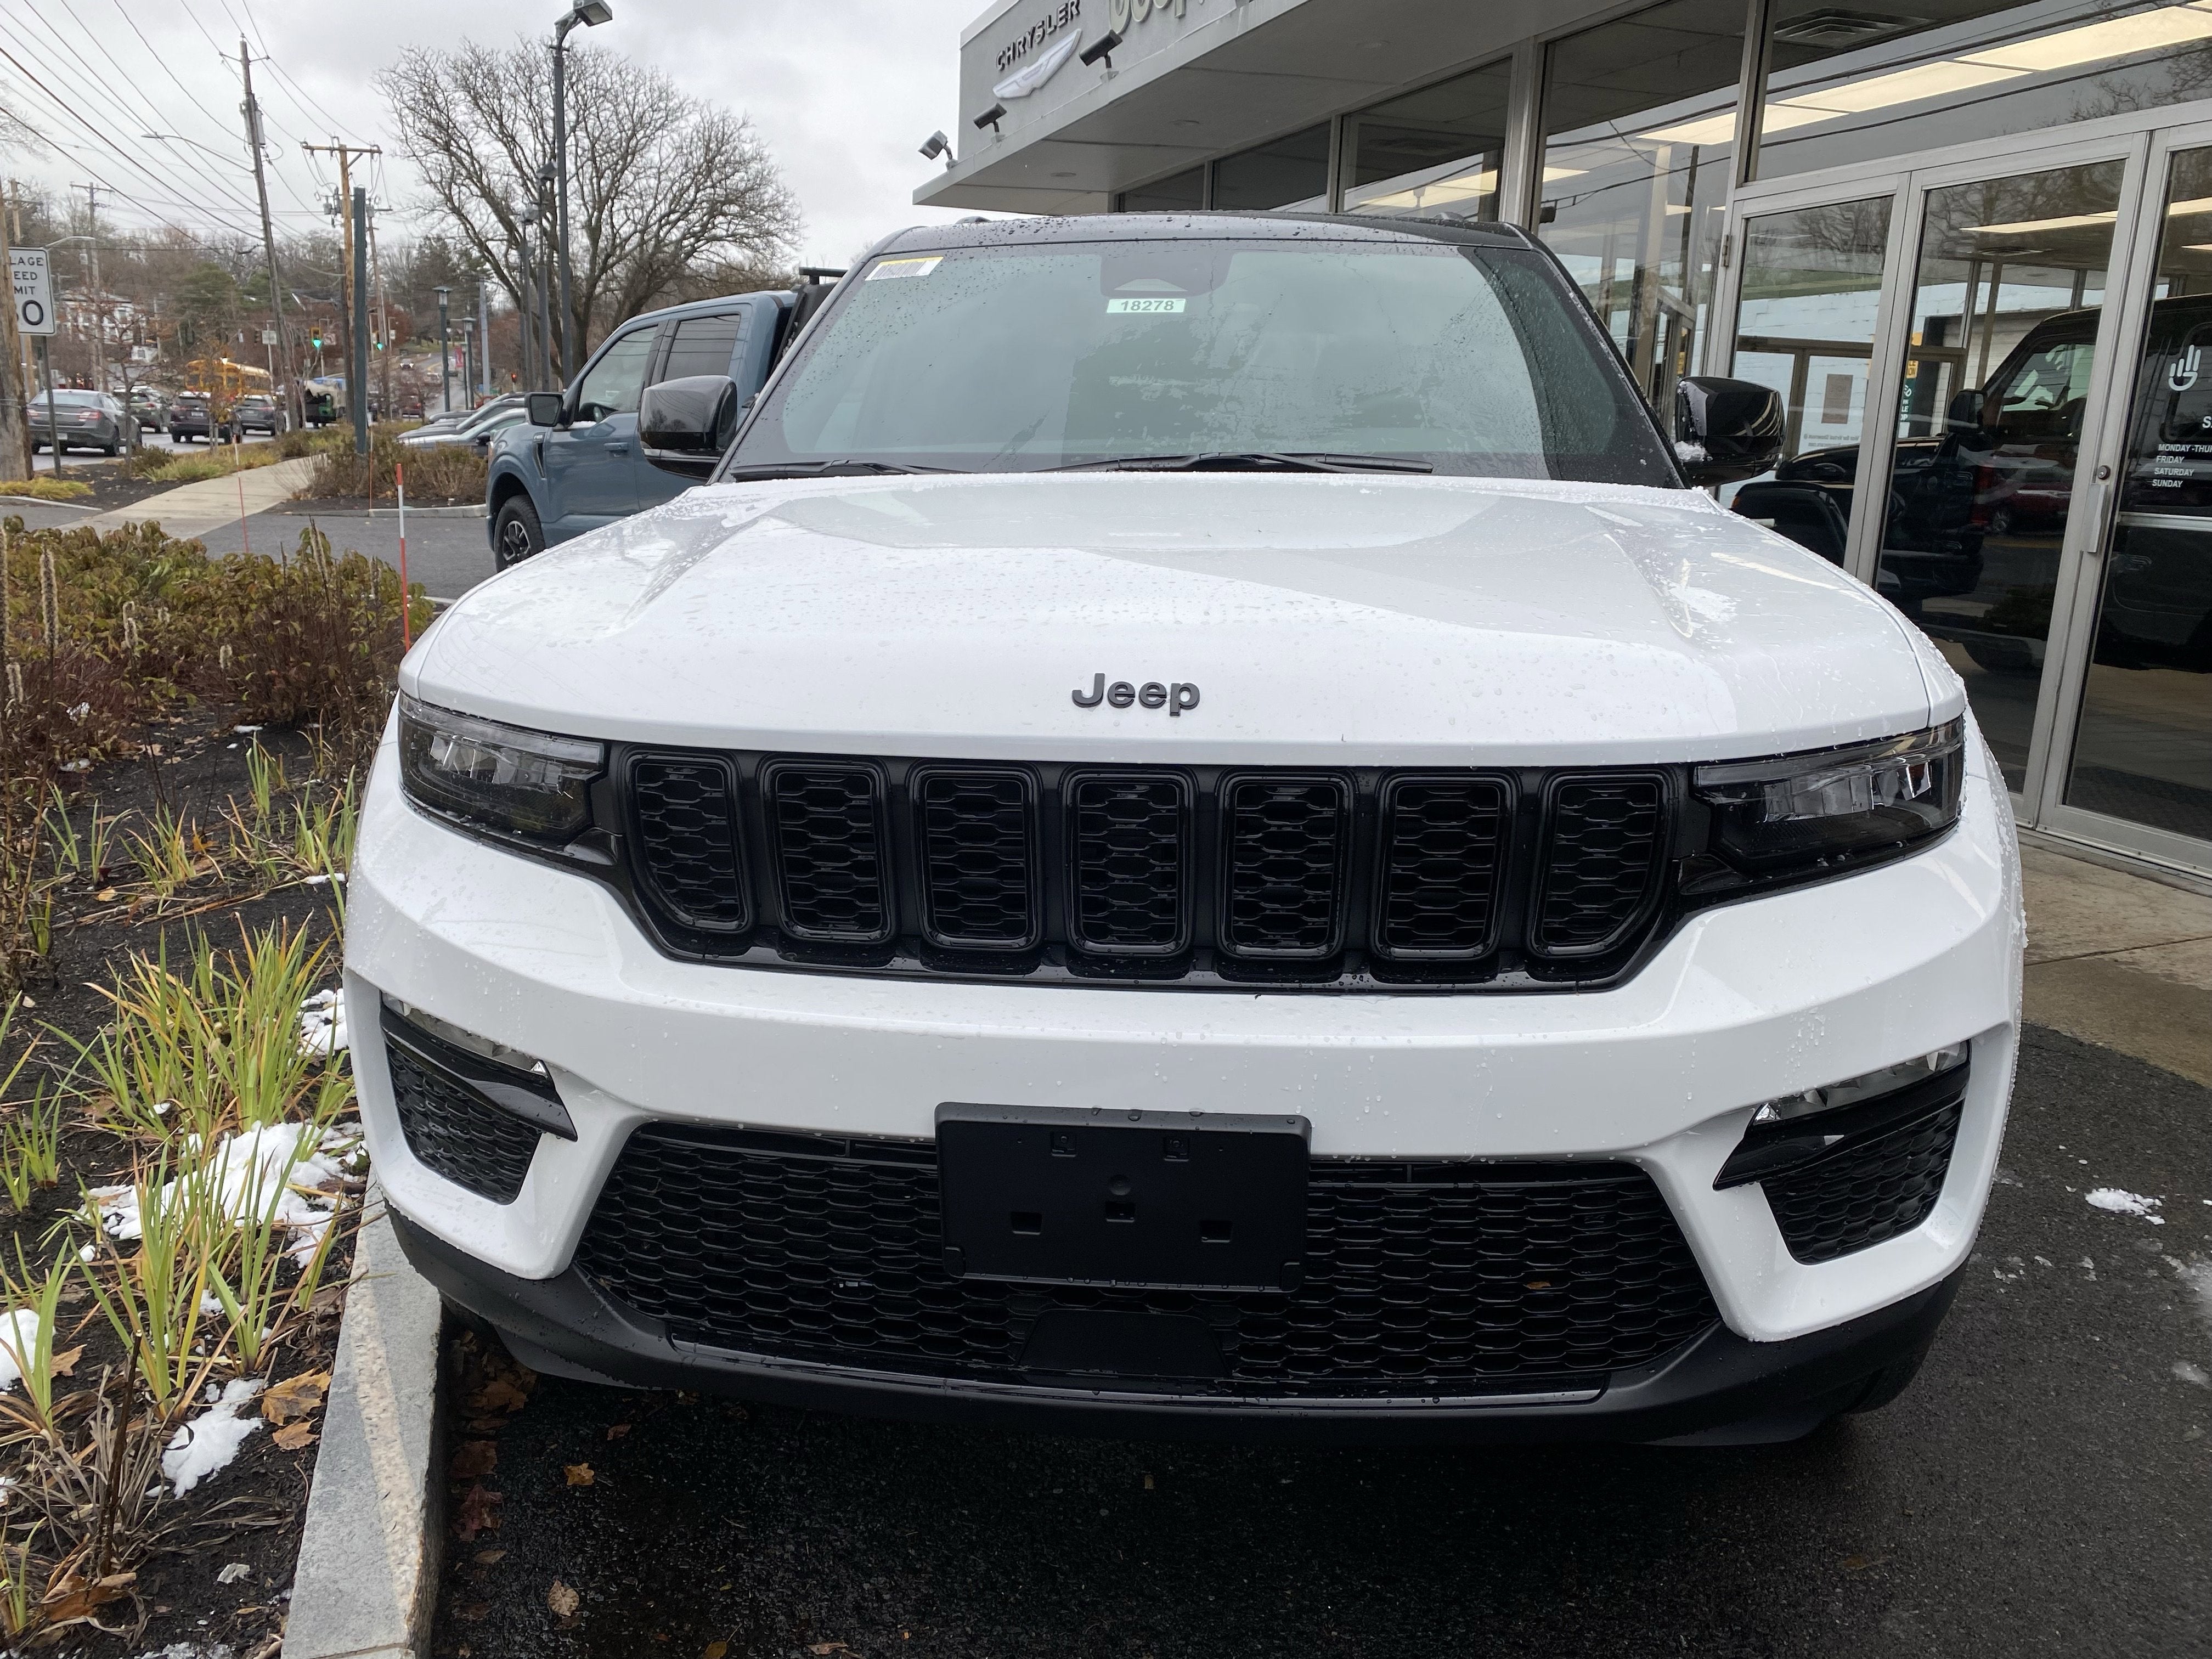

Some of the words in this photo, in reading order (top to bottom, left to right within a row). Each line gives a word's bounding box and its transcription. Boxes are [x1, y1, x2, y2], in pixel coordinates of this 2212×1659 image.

[996, 0, 1080, 71] CHRYSLER
[9, 256, 44, 266] LAGE
[14, 271, 37, 280] EED
[14, 286, 36, 295] MIT
[1121, 300, 1174, 311] 18278
[16, 300, 43, 326] 0
[2202, 415, 2212, 428] S
[2158, 444, 2192, 452] MONDAY
[2156, 455, 2185, 464] FRIDAY
[2154, 467, 2194, 476] SATURDAY
[2152, 479, 2183, 487] SUNDAY
[1071, 673, 1200, 716] Jeep
